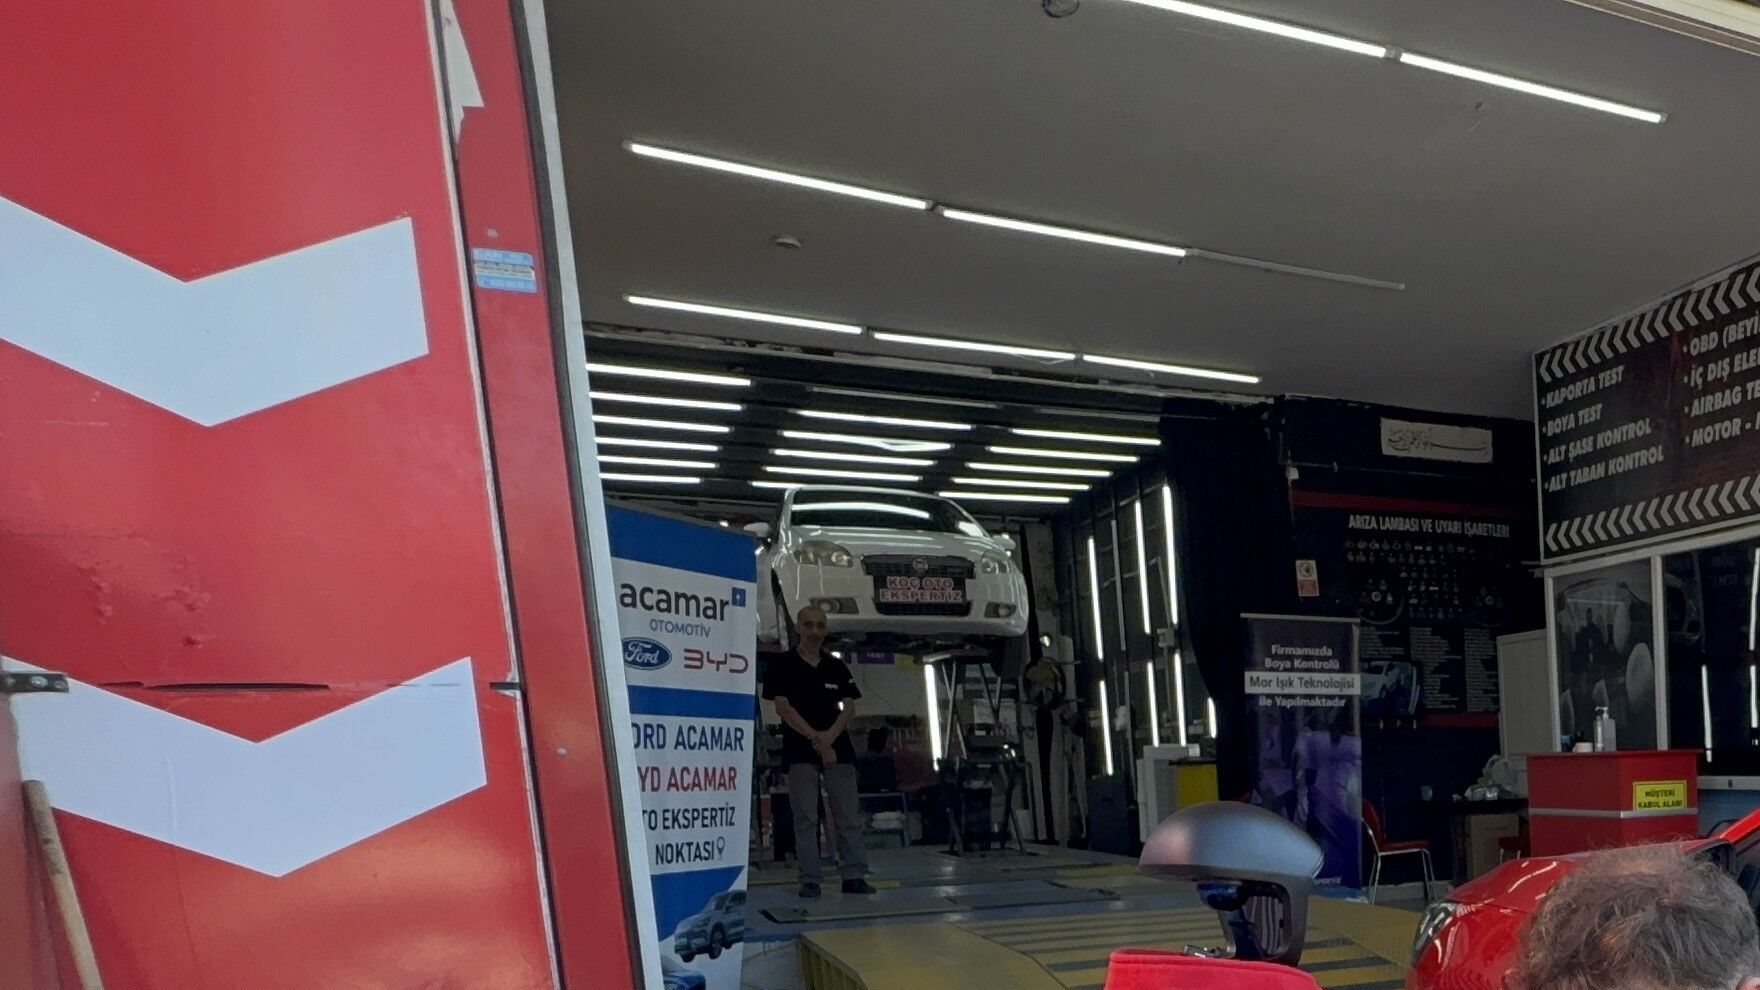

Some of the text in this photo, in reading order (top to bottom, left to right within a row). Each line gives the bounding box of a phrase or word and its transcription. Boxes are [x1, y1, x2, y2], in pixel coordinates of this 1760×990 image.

[1689, 330, 1719, 357] OBD
[1546, 365, 1624, 409] KAPORTA TEST
[1690, 365, 1704, 390] İÇ
[1707, 358, 1730, 382] DIŞ
[1691, 386, 1742, 418] AIRBAG
[1547, 403, 1603, 437] BOYA TEST
[1692, 417, 1742, 448] MOTOR
[1548, 445, 1566, 465] ALT
[1596, 417, 1652, 450] KONTROL
[1549, 445, 1664, 492] ALT TABAN KONTROL
[1348, 514, 1378, 530] ARIZA
[1379, 516, 1420, 532] LAMBASI
[1421, 519, 1433, 533] VE
[1434, 520, 1463, 534] UYARI
[619, 583, 729, 621] acamar
[649, 619, 711, 638] OTOMOTİV
[625, 641, 660, 664] Ford
[1265, 658, 1291, 670] Boya
[1250, 677, 1355, 691] Mor Işık Teknolojisi
[631, 722, 745, 751] ORD ACAMAR
[637, 766, 737, 792] YD ACAMAR
[662, 802, 736, 830] EKSPERTİZ
[655, 841, 714, 865] NOKTASI
